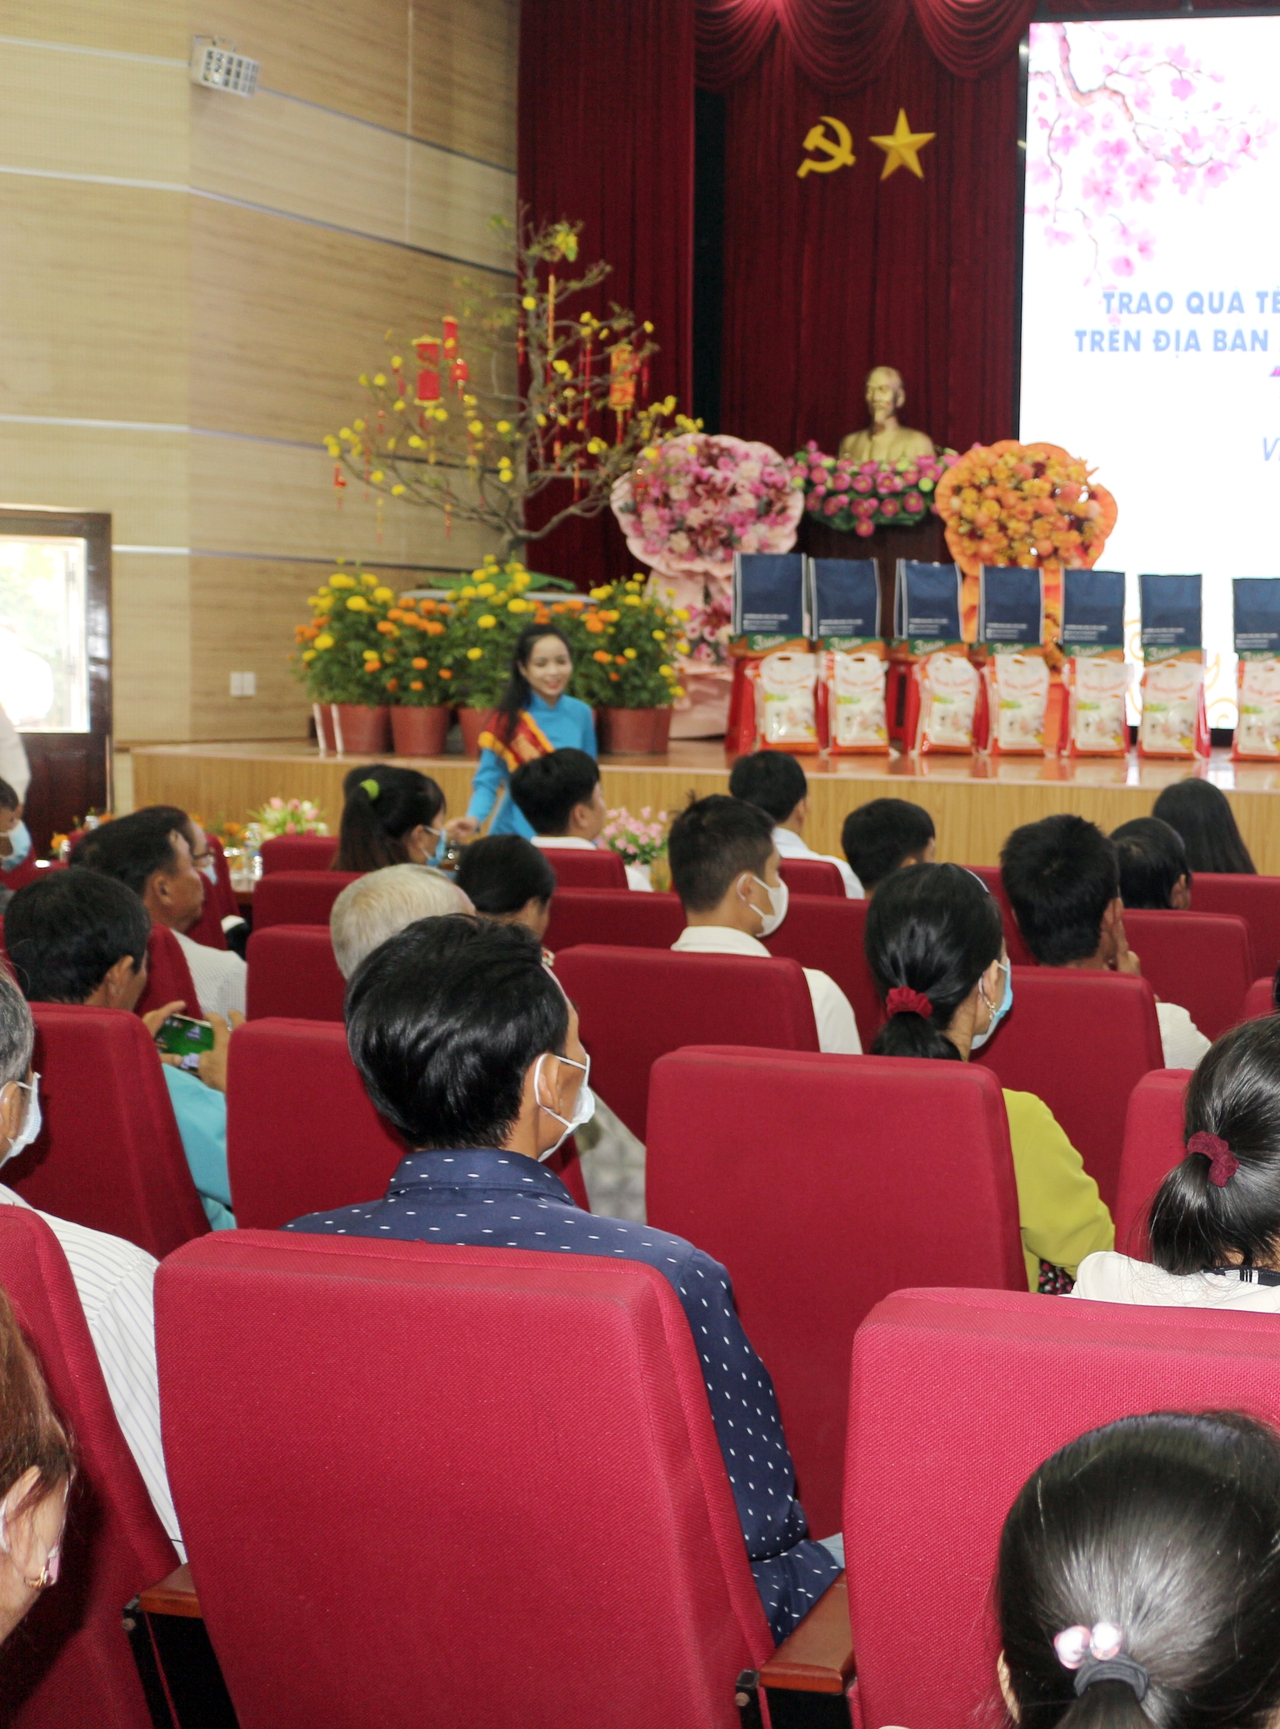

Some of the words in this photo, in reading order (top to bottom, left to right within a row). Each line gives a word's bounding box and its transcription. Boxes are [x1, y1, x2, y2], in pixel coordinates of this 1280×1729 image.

[1103, 290, 1173, 314] TRAO
[1186, 286, 1245, 314] QUÀ
[1075, 325, 1141, 352] TRÊN
[1153, 329, 1201, 357] ĐỊA
[1213, 324, 1268, 351] BÀN
